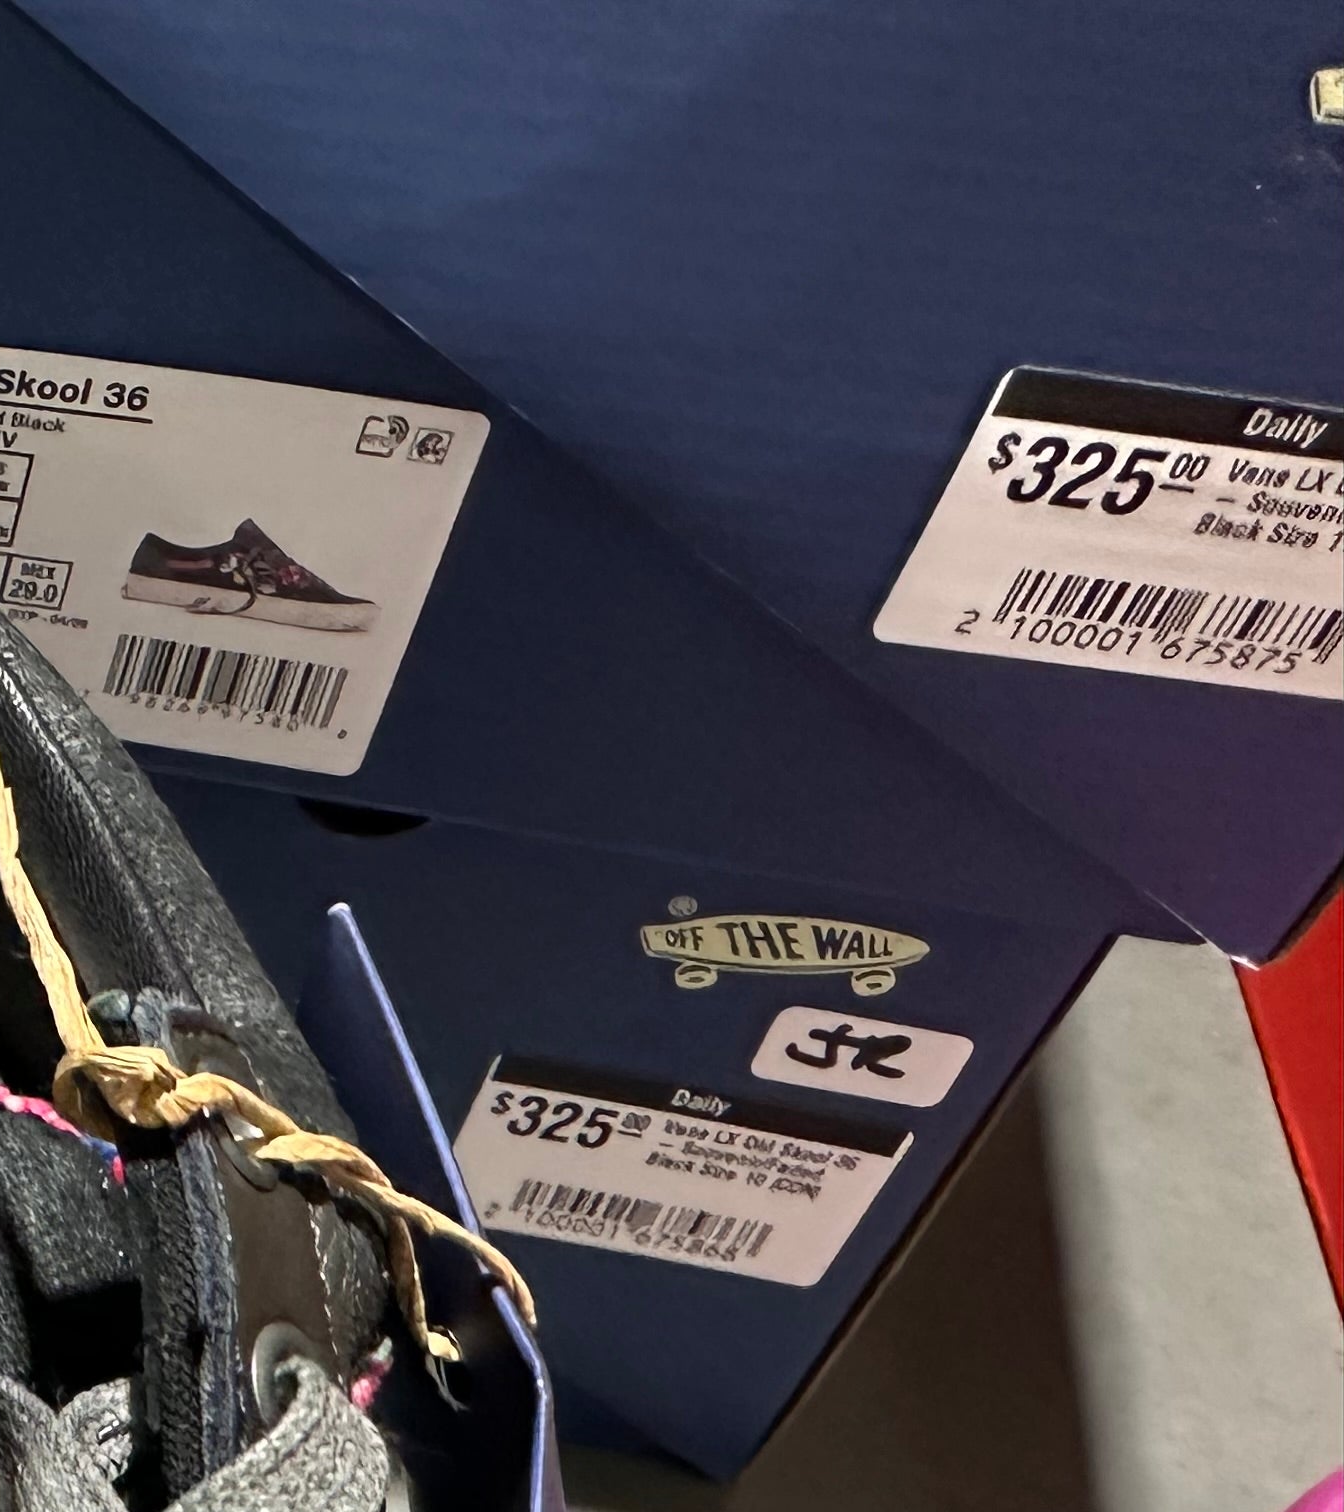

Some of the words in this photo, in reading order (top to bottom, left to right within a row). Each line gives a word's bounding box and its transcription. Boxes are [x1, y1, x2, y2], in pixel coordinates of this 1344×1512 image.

[103, 382, 150, 411] 36
[10, 412, 66, 433] Black
[1243, 407, 1329, 449] Daily
[1228, 458, 1291, 488] Vans
[1294, 467, 1335, 493] LX
[1247, 490, 1344, 524] Souveni
[1194, 511, 1264, 541] Black
[1267, 522, 1319, 548] Size
[954, 609, 981, 636] 2
[1009, 614, 1143, 657] 100001
[1160, 636, 1303, 675] 675875
[665, 926, 704, 951] OFF
[716, 921, 804, 960] THE
[812, 925, 894, 960] WALL
[671, 1088, 732, 1117] Daily
